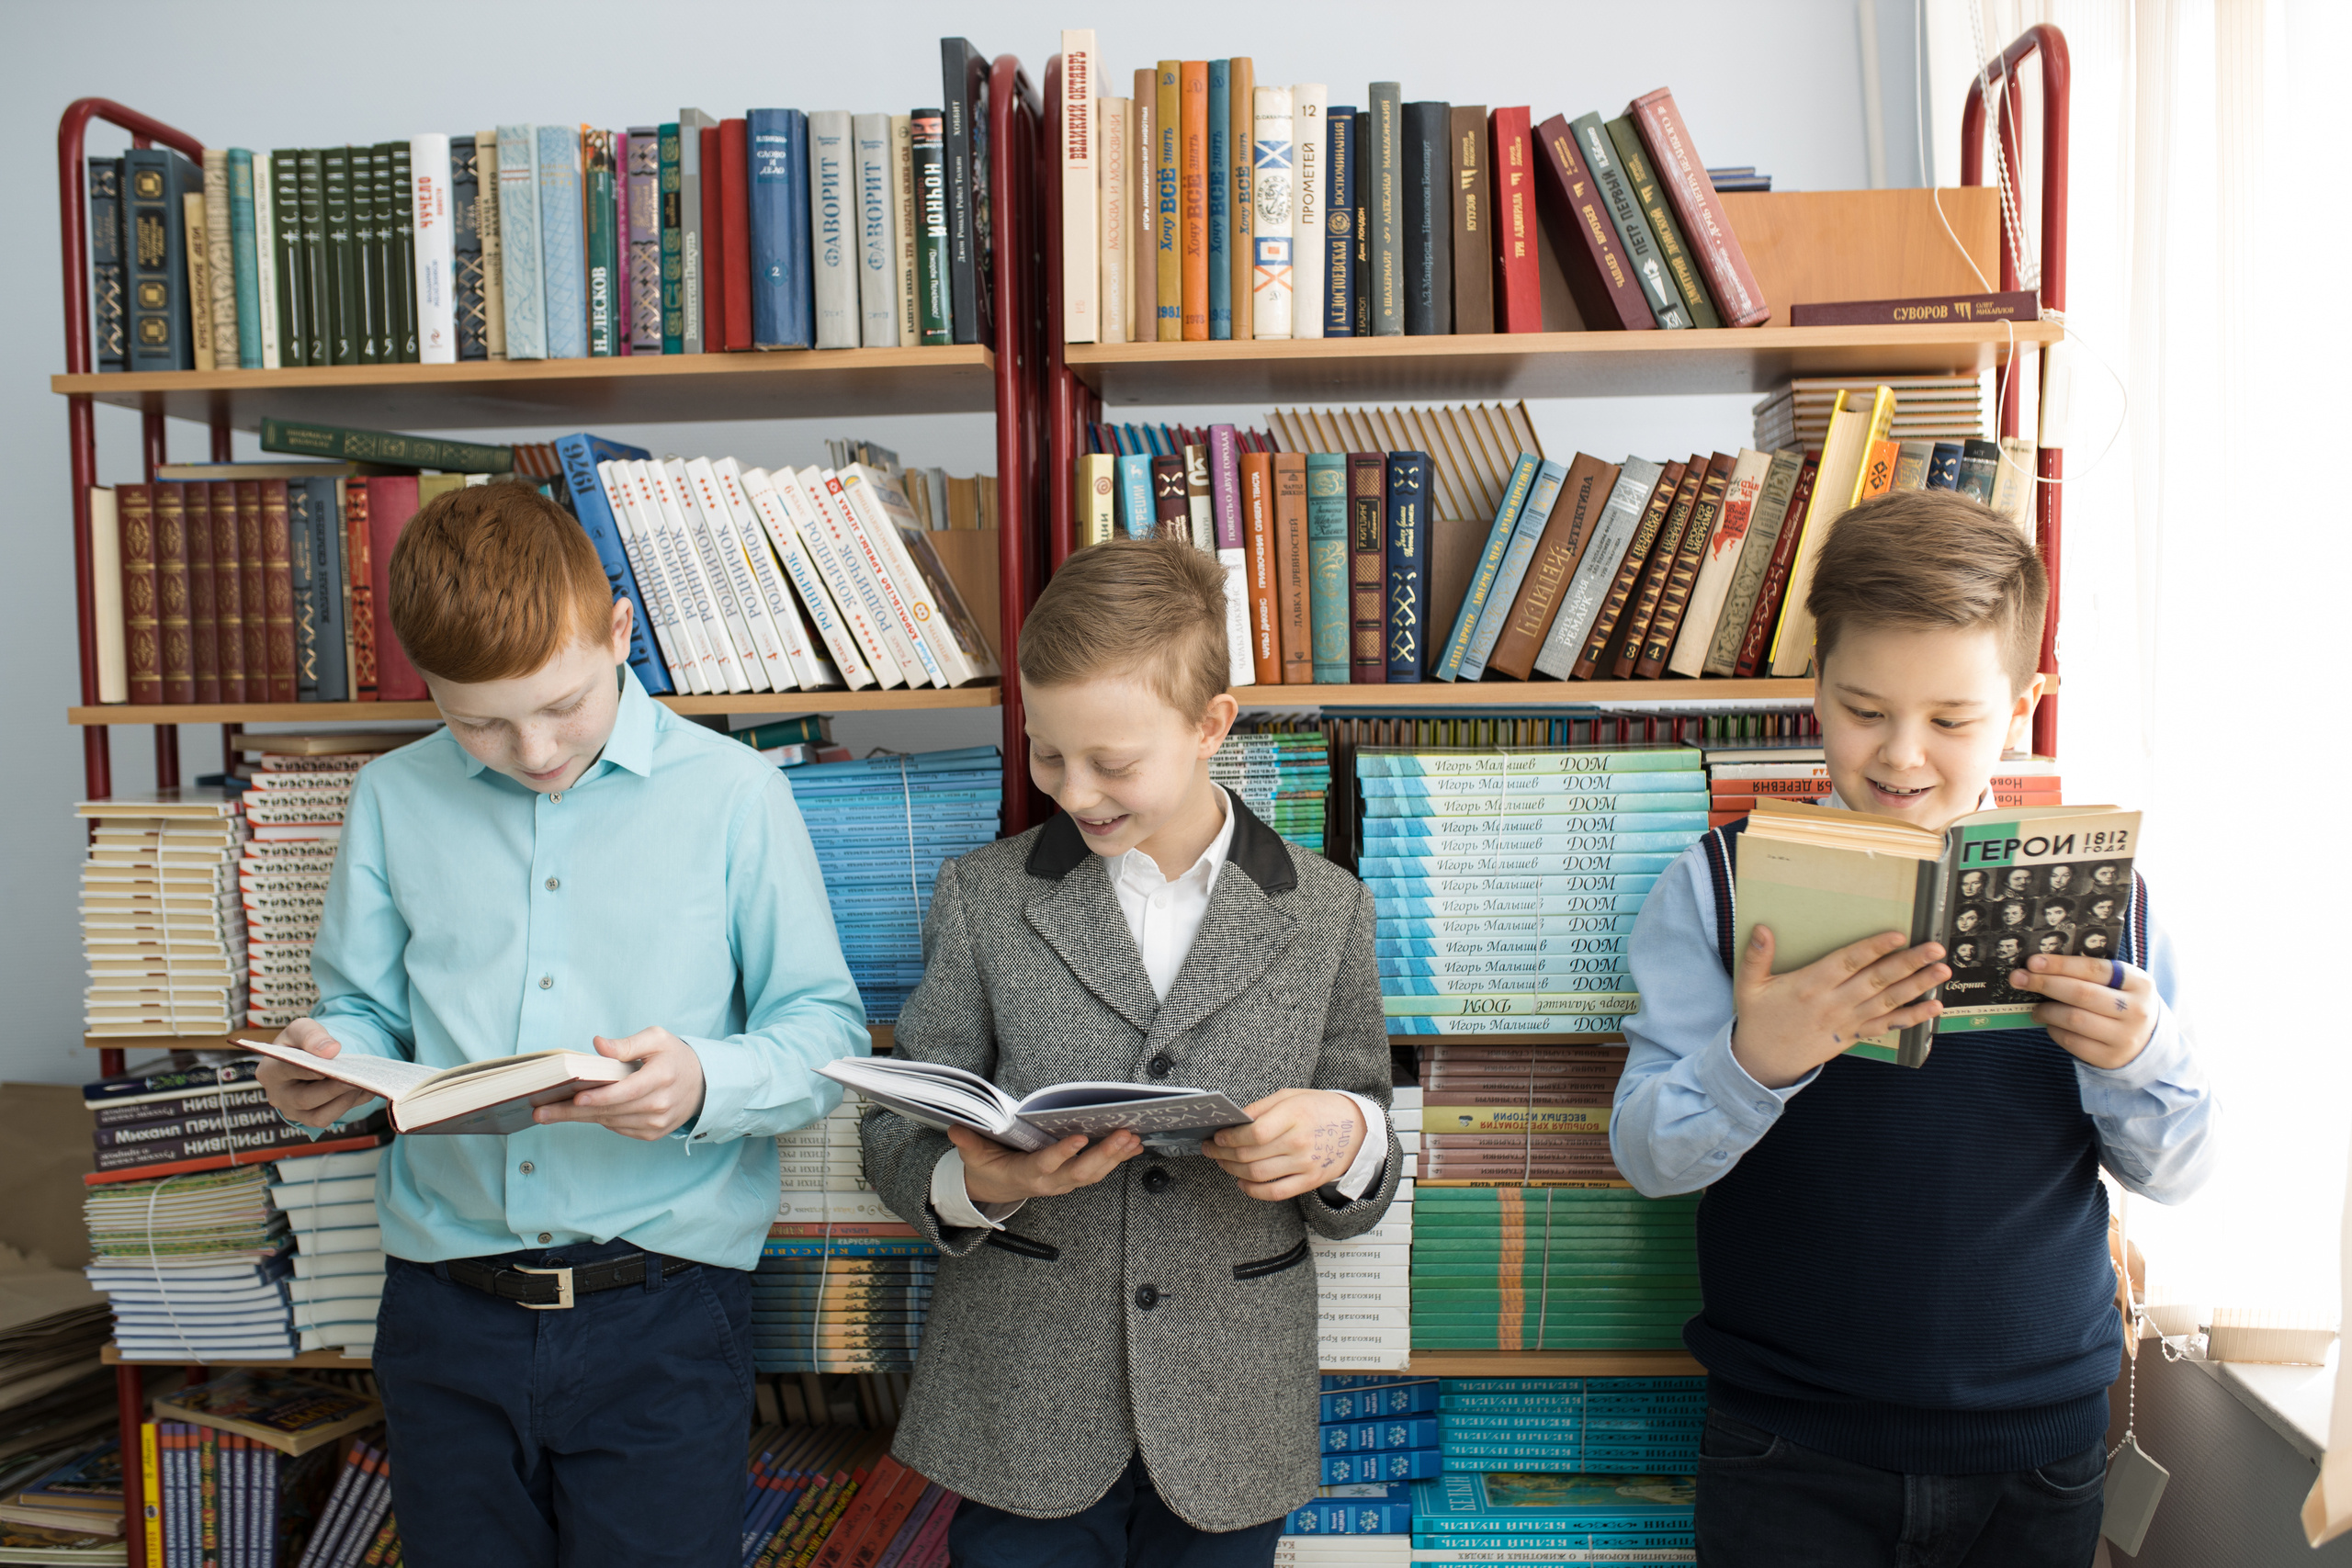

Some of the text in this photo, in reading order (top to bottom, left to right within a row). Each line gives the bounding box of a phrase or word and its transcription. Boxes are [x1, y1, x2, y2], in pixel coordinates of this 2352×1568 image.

[952, 100, 961, 136] ХОББИТ
[1068, 51, 1088, 160] ВЕЛИКИЙ ОКТЯБРЬ
[1302, 105, 1317, 117] 12
[1381, 99, 1391, 169] МАКЕДОНСКИЙ
[1188, 134, 1201, 171] знать
[1334, 121, 1345, 206] ВОСПОМИНАНИЯ
[1421, 140, 1433, 185] Бонапарт
[1108, 114, 1121, 250] МОСКВА И МОСКВИЧИ
[1157, 128, 1177, 253] Хочу ВСЁ знать
[1301, 142, 1315, 224] ПРОМЕТЕЙ
[1661, 116, 1722, 238] ДОЧЬ ПЕТРА ВЕЛИКОГО
[418, 176, 433, 229] ЧУЧЕЛО
[820, 157, 842, 267] ФАВОРИТ
[923, 163, 947, 238] НОЧНОЙ
[1383, 172, 1391, 224] АЛЕКСАНДР
[1422, 186, 1430, 233] Наполеон
[1465, 194, 1476, 231] КУТУЗОВ
[1601, 169, 1648, 256] ПЕТР ПЕРВЫЙ
[864, 161, 885, 271] ФАВОРИТ
[903, 197, 912, 238] ВОЗРАСТА
[1238, 206, 1251, 235] Хочу
[1512, 192, 1525, 258] ТРИ АДМИРАЛА
[904, 243, 914, 258] ТРИ
[957, 240, 966, 263] Джон
[1187, 221, 1203, 256] Хочу
[771, 266, 780, 277] 2
[1649, 207, 1703, 306] ДМИТРИЙ ДОНСКОЙ
[684, 231, 698, 341] Валентин Пикуль
[591, 266, 607, 353] Н. ЛЕСКОВ
[1158, 305, 1181, 320] 1981
[1894, 305, 1949, 321] СУВОРОВ
[291, 340, 300, 359] 1
[312, 340, 322, 358] 2
[339, 339, 348, 357] 3
[364, 338, 375, 357] 4
[384, 338, 393, 356] 5
[406, 335, 416, 354] 6
[1220, 431, 1231, 469] ГОРОДАХ
[562, 442, 597, 497] 1976
[1223, 471, 1233, 494] ДВУХ
[1226, 502, 1236, 541] ПОВЕСТЬ
[1251, 471, 1267, 589] ПРИКЛЮЧЕНИЯ ОЛИВЕРА ТВИСТА
[653, 524, 697, 620] РОДНИЧОК
[691, 523, 738, 618] РОДНИЧОК
[716, 524, 761, 619] РОДНИЧОК
[740, 521, 786, 615] РОДНИЧОК
[802, 520, 858, 610] РОДНИЧОК
[838, 497, 919, 641] КОРОЛЕВСТВО КРИВЫХ ЗЕРКАЛ
[1289, 518, 1303, 628] ЛАВКА ДРЕВНОСТЕЙ
[1516, 538, 1572, 638] МАСТЕРА
[1566, 475, 1594, 558] ДЕТЕКТИВА
[785, 551, 832, 632] РОДНИЧОК
[838, 544, 893, 633] РОДНИЧОК
[1449, 644, 1459, 669] АГАТА
[1458, 613, 1474, 647] КРИСТИ
[1472, 570, 1492, 608] ДЖЕЙМС
[1491, 540, 1504, 560] ЧЕЙЗ
[1260, 598, 1271, 660] ЧАРЛЬЗ ДИККЕНС
[1555, 579, 1589, 645] ЭРИХ МАРИЯ
[1563, 595, 1593, 648] РЕМАРК
[843, 664, 856, 675] 6
[1590, 649, 1599, 661] 1
[1625, 646, 1634, 659] 3
[1647, 645, 1659, 660] 4
[1438, 777, 1540, 793] Игорь Малышев
[1563, 774, 1613, 791] ДОМ
[1752, 779, 1812, 794] ДЕРЕВНЯ
[1962, 830, 2129, 863] ГЕРОИ 1812
[2083, 843, 2126, 853] ГОДА
[1446, 939, 1547, 954] Игорь Малышев
[1571, 937, 1622, 953] ДОМ
[1447, 977, 1549, 993] Игорь Малышев
[1573, 976, 1624, 992] ДОМ
[1945, 980, 1987, 993] Сборник
[1461, 998, 1511, 1015] ДОМ
[1536, 998, 1637, 1013] Игорь Малышев
[1449, 1018, 1550, 1032] Игорь Малышев
[1574, 1015, 1624, 1032] ДОМ
[115, 1111, 276, 1145] Михаил ПРИШВИН
[1480, 1121, 1600, 1131] БОЛЬШАЯ ХРЕСТОМАТИЯ
[1493, 1112, 1538, 1122] ИСТОРИЙ
[184, 1130, 275, 1156] ПРИШВИН
[837, 1237, 881, 1246] КАРУСЕЛЬ
[1440, 1521, 1566, 1531] БЕЛЫЙ ПУДЕЛЬ
[1507, 1552, 1567, 1561] ЖИВОТНЫХ
[1584, 1552, 1631, 1561] КОРОВИН
